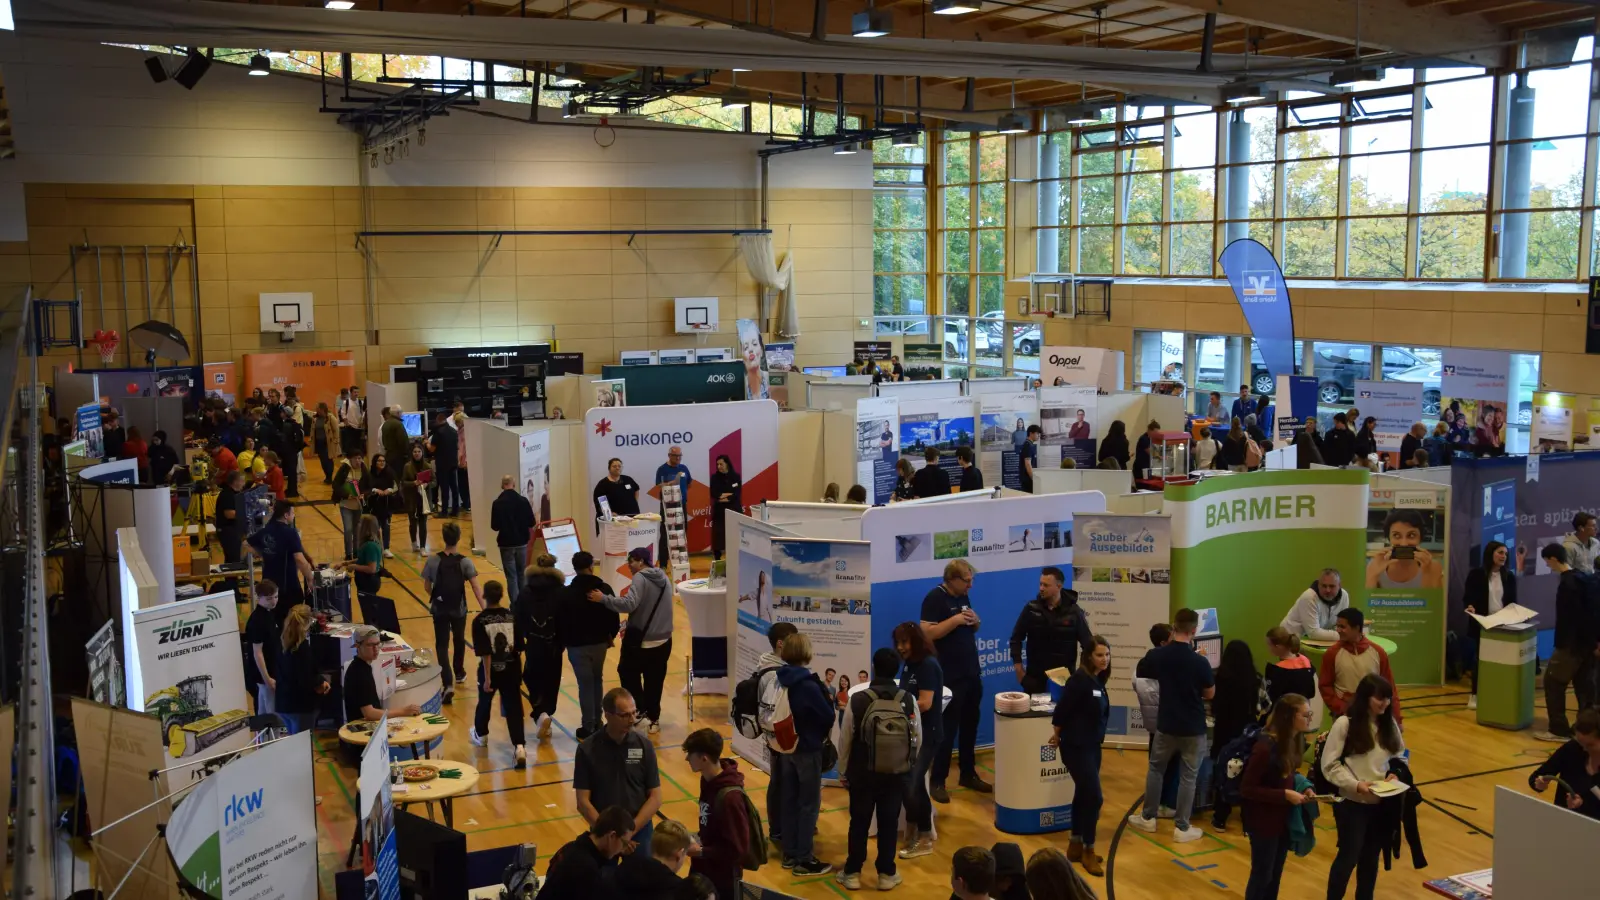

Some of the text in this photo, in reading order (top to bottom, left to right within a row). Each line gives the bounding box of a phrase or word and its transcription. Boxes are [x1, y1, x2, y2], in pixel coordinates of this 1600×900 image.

[1049, 354, 1081, 366] Oppel
[707, 374, 726, 383] AOK
[692, 507, 711, 517] weil
[1206, 495, 1316, 528] BARMER
[1090, 532, 1127, 542] Sauber
[1090, 543, 1154, 554] Ausgebildet
[158, 620, 204, 645] ZÜRN
[170, 648, 190, 658] LIEBEN
[191, 642, 215, 652] TECHNIK.
[225, 788, 263, 826] rkw
[244, 853, 257, 864] RKW
[258, 846, 273, 858] reden
[274, 838, 288, 850] nicht
[288, 835, 298, 843] nur
[247, 860, 269, 873] Respekt
[273, 852, 283, 861] wir
[283, 845, 298, 856] leben
[228, 885, 241, 897] Denn
[241, 873, 263, 887] Respekt
